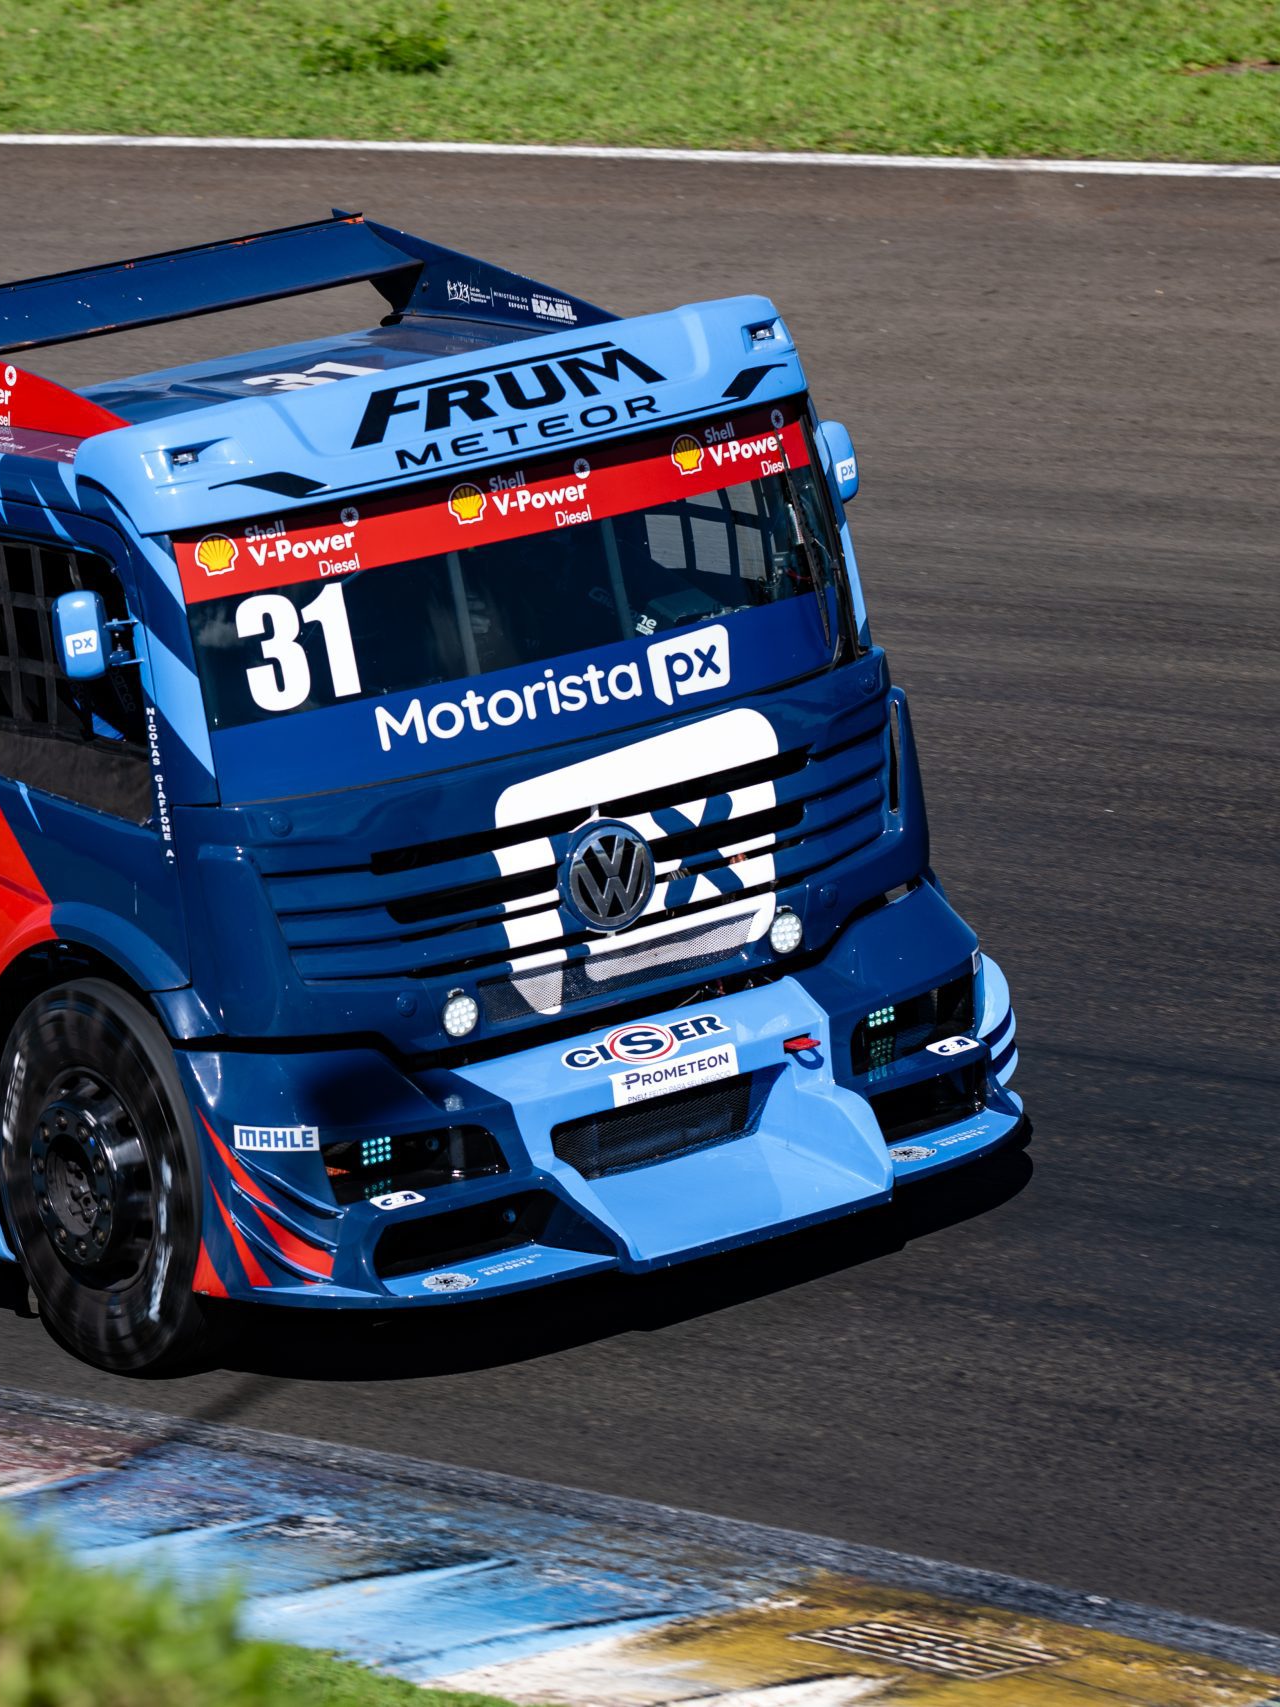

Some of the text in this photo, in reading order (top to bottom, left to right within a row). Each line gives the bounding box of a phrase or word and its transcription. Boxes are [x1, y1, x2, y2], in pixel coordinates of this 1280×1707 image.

[531, 298, 577, 320] BRASIL
[351, 341, 668, 450] FRUM
[396, 395, 662, 470] METEOR
[705, 422, 735, 444] Shell
[709, 431, 784, 467] V-Power
[489, 470, 526, 493] Shell
[761, 456, 791, 475] Diesel
[492, 480, 587, 516] V-Power
[244, 520, 286, 543] Shell
[555, 506, 592, 527] Diesel
[248, 530, 356, 567] V-Power
[318, 555, 361, 577] Diesel
[235, 582, 362, 712] 31
[374, 661, 642, 752] Motorista
[146, 707, 161, 766] NICOLAS
[154, 774, 172, 841] GIAFFONE
[563, 1012, 729, 1069] CISER
[623, 1052, 729, 1090] PROMETEON
[238, 1127, 314, 1150] MAHLE
